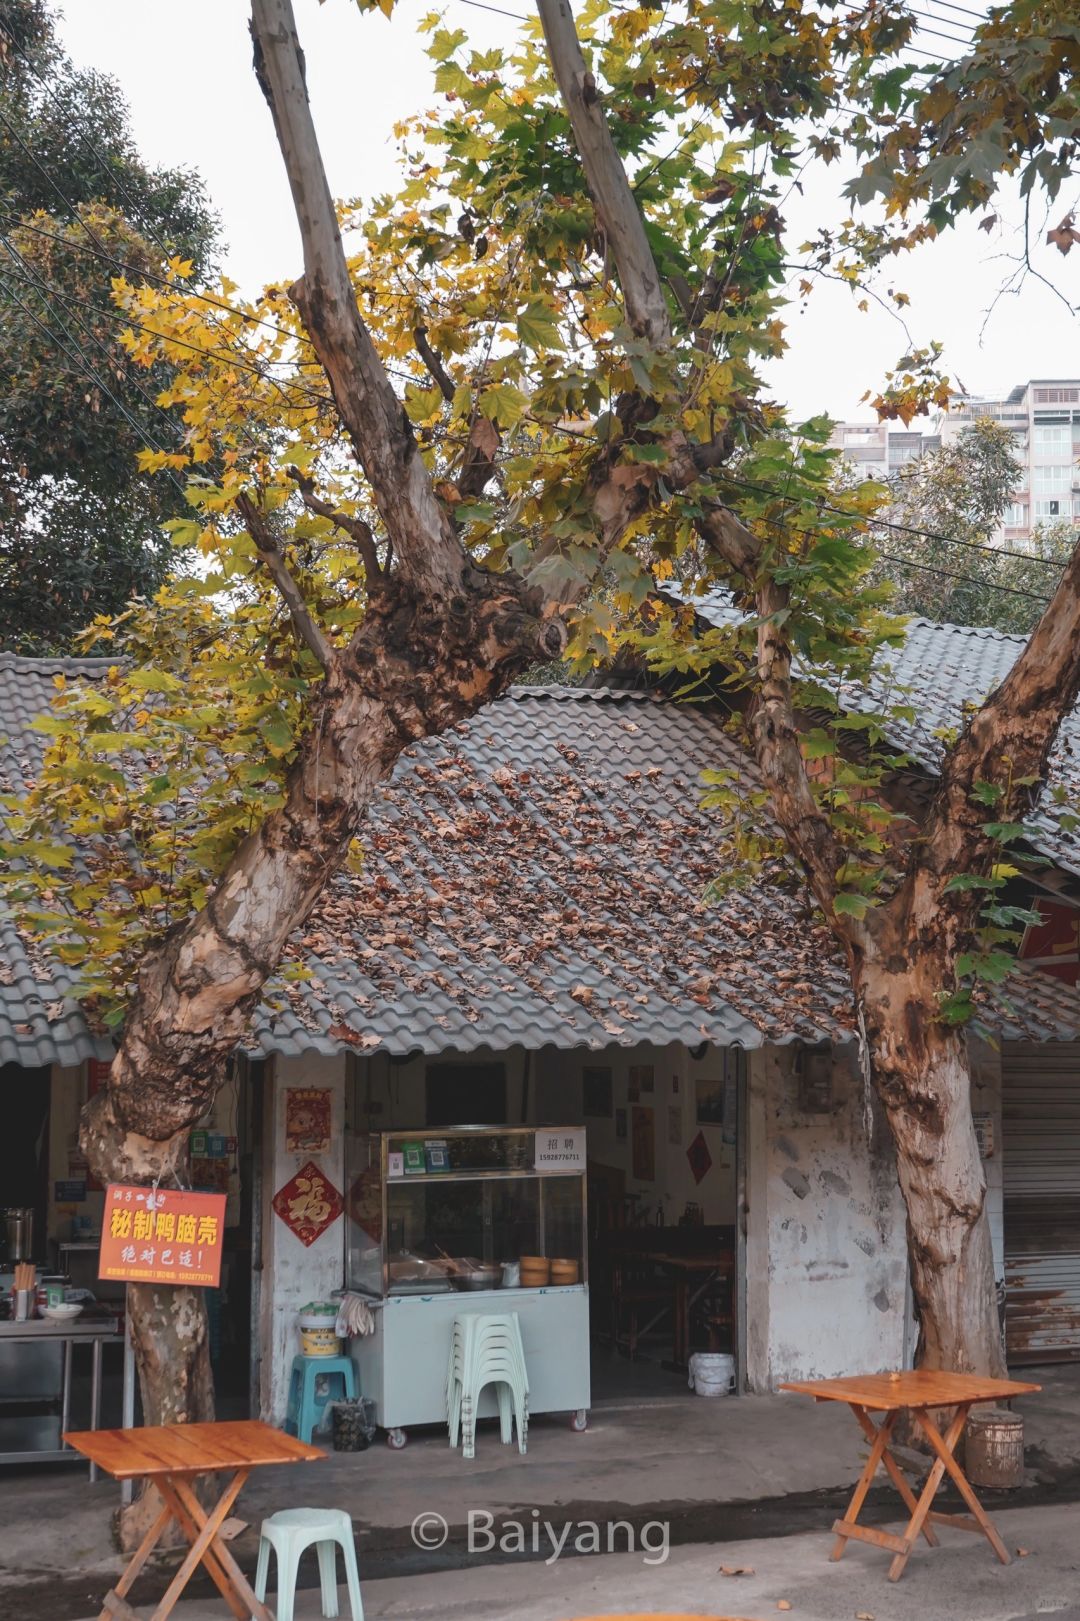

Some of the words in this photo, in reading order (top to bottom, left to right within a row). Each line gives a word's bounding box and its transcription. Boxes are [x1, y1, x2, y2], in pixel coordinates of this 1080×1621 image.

[548, 1139, 574, 1150] 招聘
[110, 1208, 218, 1245] 秘制鸭脑壳
